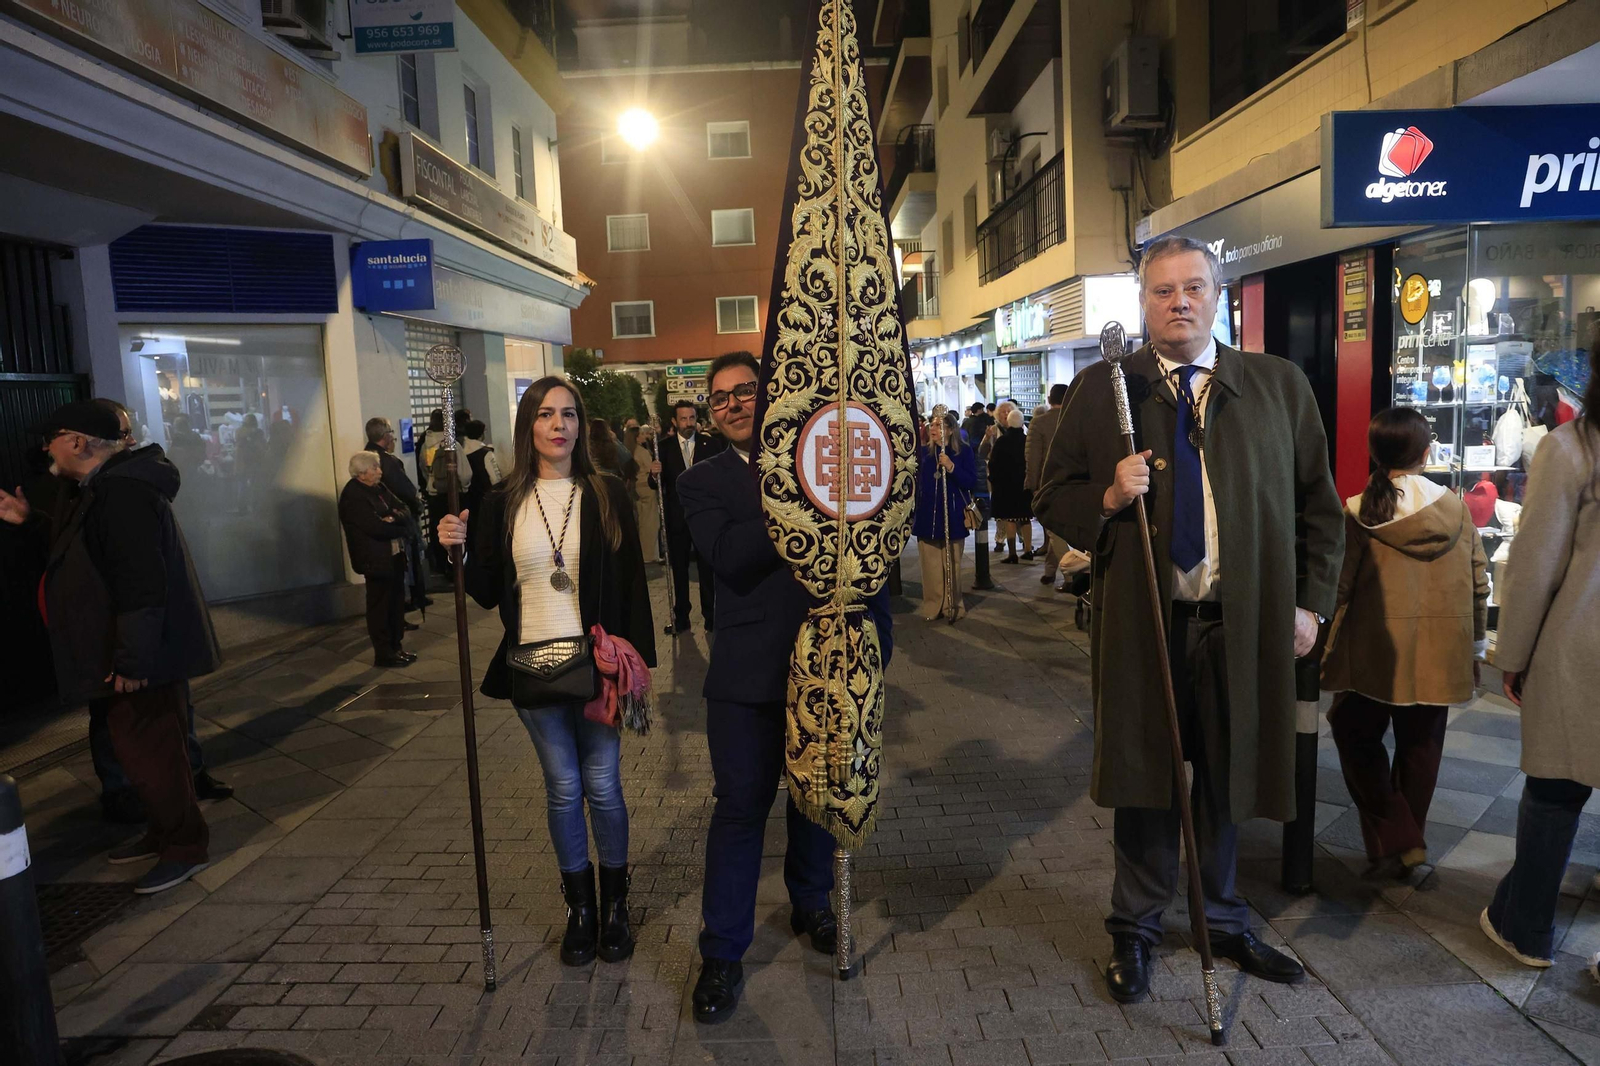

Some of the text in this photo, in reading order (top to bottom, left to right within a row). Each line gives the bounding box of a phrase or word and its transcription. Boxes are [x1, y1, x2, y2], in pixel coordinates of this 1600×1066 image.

[366, 24, 440, 39] 956 653 969
[366, 38, 443, 49] www.podocorp.es
[416, 155, 457, 196] FISCONTAL
